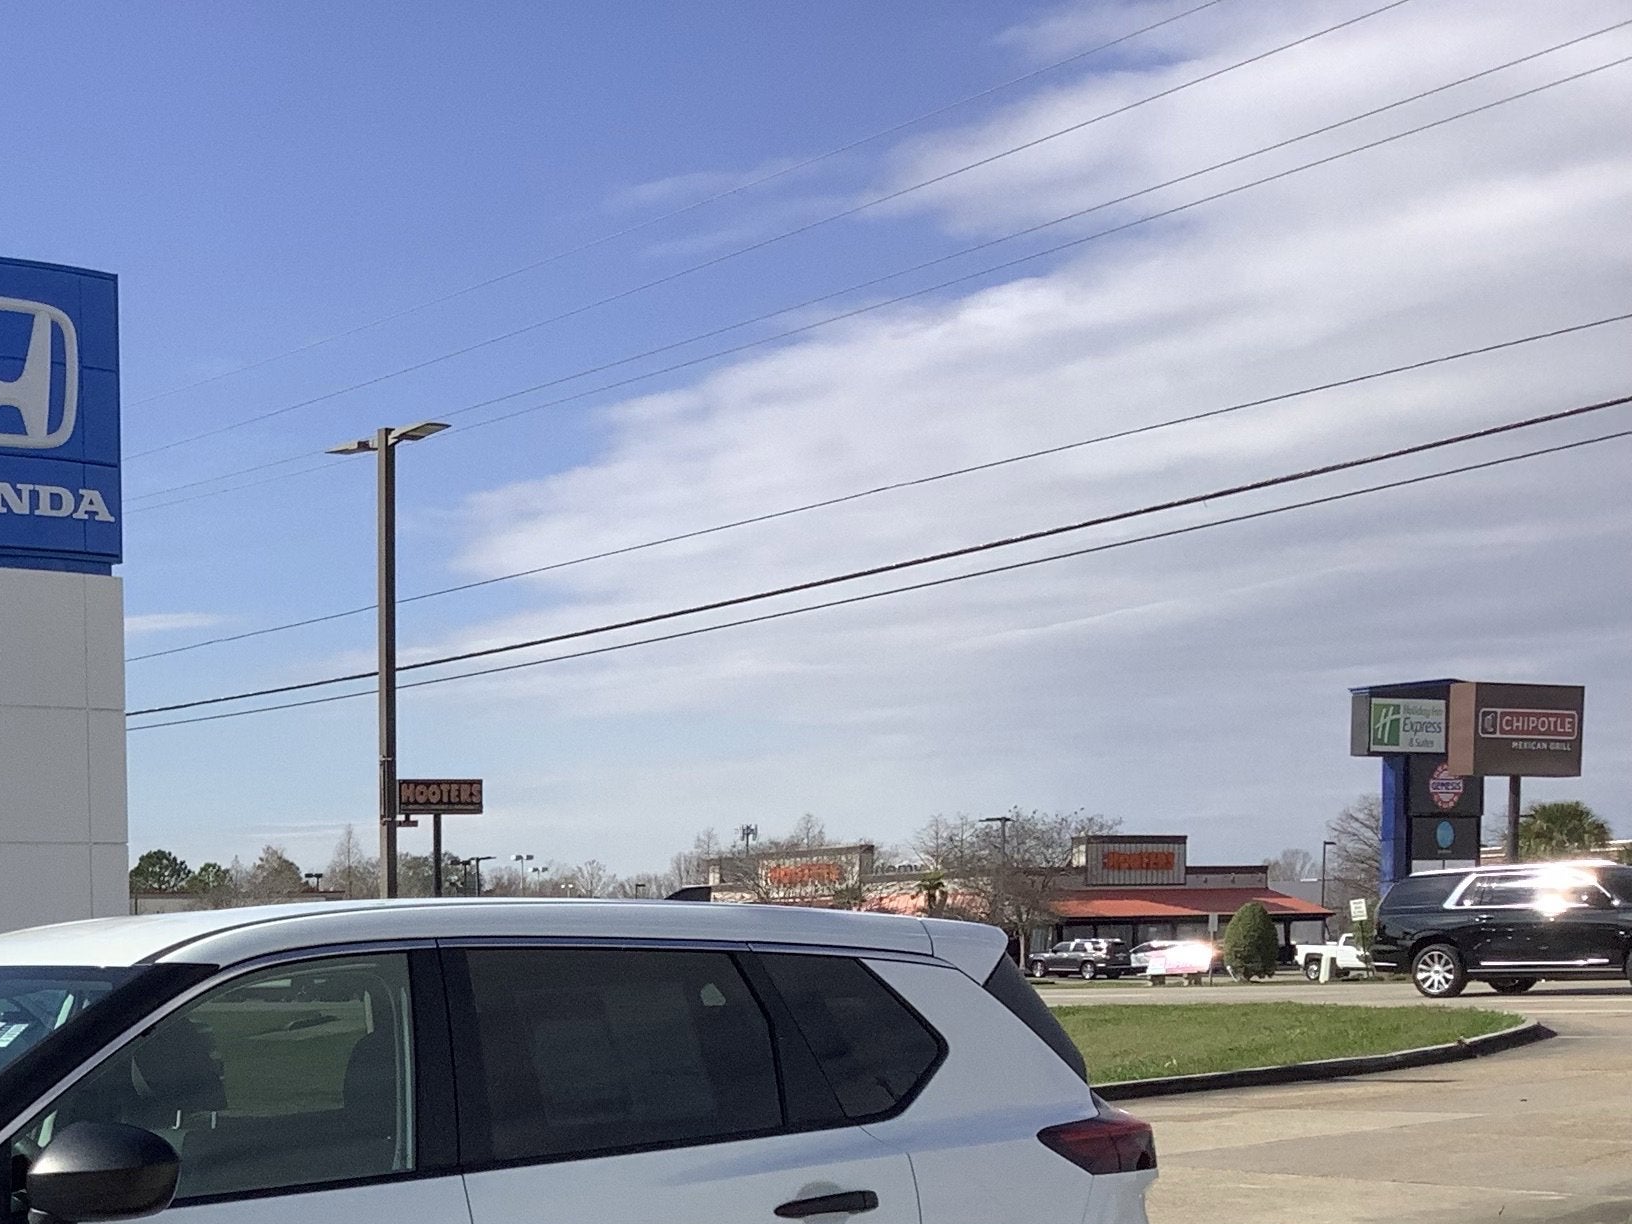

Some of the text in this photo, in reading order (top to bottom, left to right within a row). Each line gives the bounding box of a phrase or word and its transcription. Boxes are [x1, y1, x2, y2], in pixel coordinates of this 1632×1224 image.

[1402, 717, 1443, 736] Express
[1502, 716, 1573, 732] CHIPOTLE
[401, 783, 480, 803] HOOTERS
